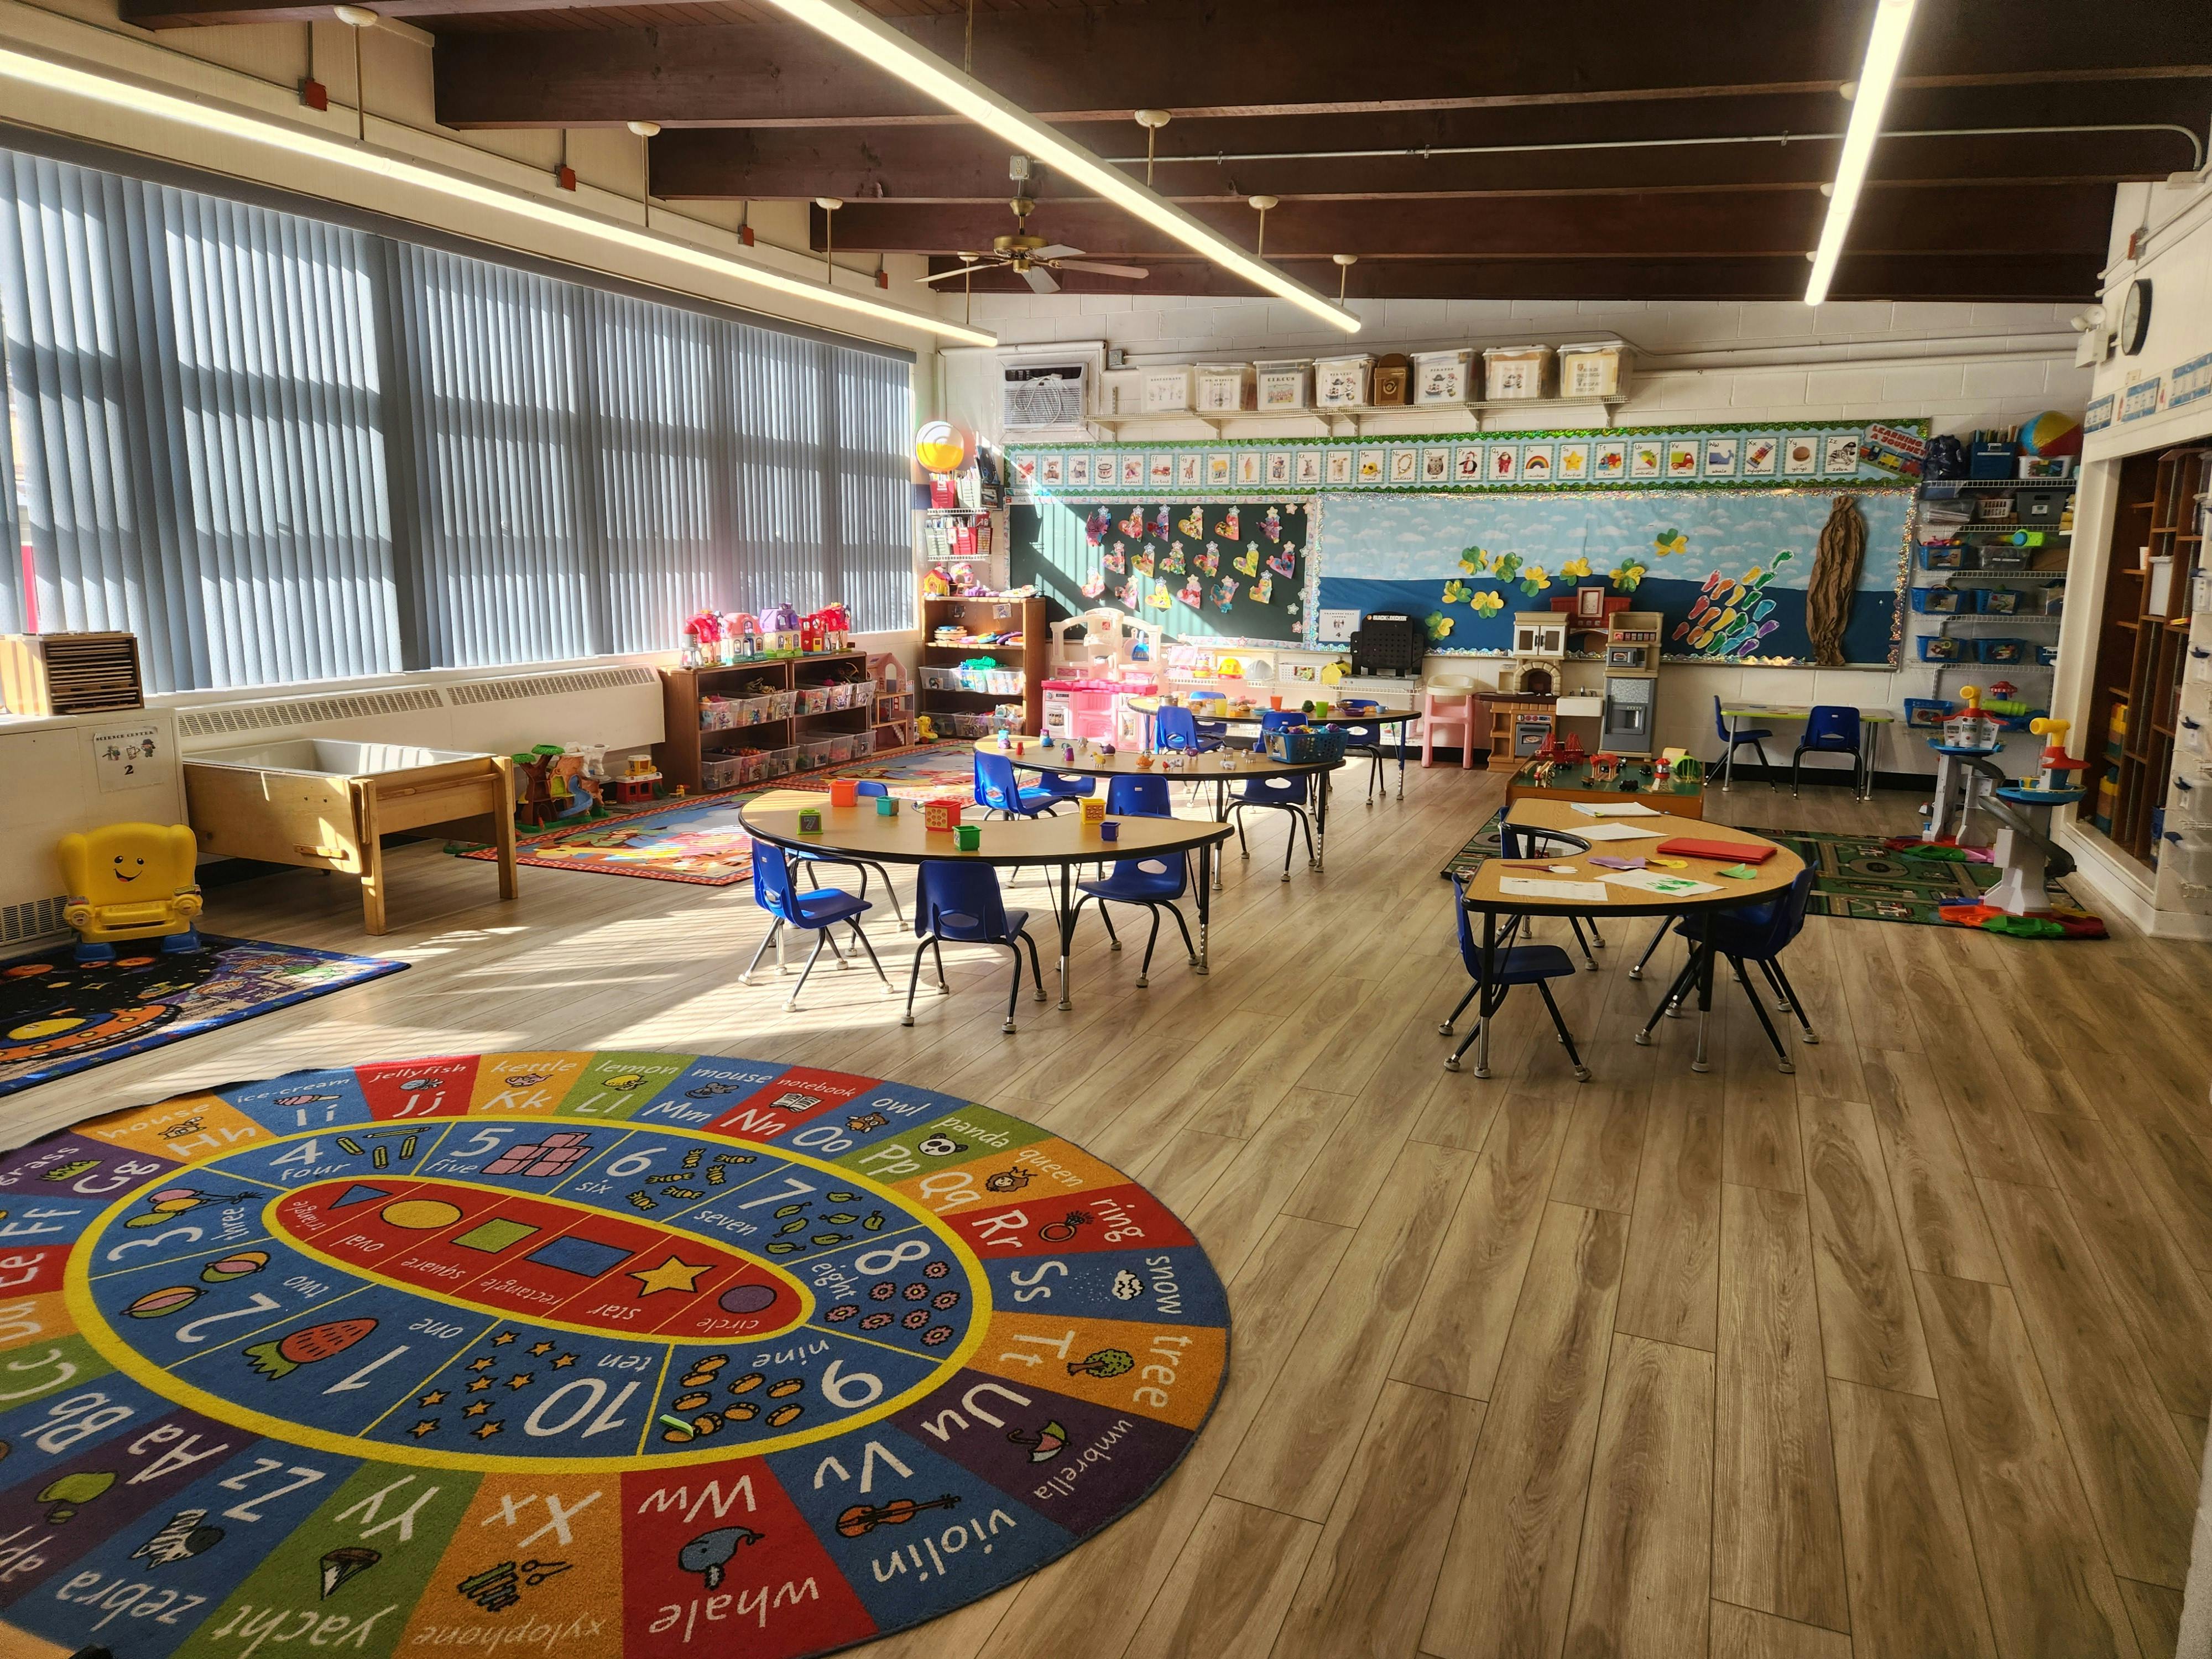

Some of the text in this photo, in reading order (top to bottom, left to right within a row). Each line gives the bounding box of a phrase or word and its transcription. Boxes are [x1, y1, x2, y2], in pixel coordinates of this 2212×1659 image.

[1788, 439, 1797, 448] Yy
[1872, 425, 1923, 447] LEARNING
[1881, 436, 1927, 456] JOURNEY
[1269, 454, 1275, 463] Jj
[124, 764, 134, 775] 2
[804, 816, 816, 830] 7
[372, 1062, 467, 1083] jellyfish
[492, 1058, 578, 1073] kettle
[594, 1060, 679, 1075] lemon
[691, 1065, 773, 1084] mouse
[236, 1076, 353, 1103] ice-cream
[479, 1092, 554, 1111] Kk
[777, 1076, 856, 1097] notebook
[295, 1103, 337, 1128] Ii
[393, 1092, 447, 1118] Jj
[576, 1094, 627, 1113] Ll
[643, 1100, 713, 1124] Mm
[870, 1094, 931, 1118] owl
[97, 1102, 210, 1140] house
[721, 1109, 779, 1137] Nn
[939, 1115, 1010, 1149] panda
[168, 1125, 257, 1157] Hh
[269, 1137, 324, 1167] 4
[450, 1126, 502, 1155] 5
[792, 1125, 853, 1155] Oo
[72, 1160, 160, 1193] Gg
[280, 1159, 352, 1181] four
[426, 1159, 478, 1177] five
[608, 1147, 666, 1177] 6
[858, 1143, 922, 1177] Pp
[1014, 1146, 1084, 1188] queen
[575, 1178, 613, 1196] six
[738, 1177, 817, 1211] 7
[919, 1171, 983, 1213] Qq
[210, 1206, 245, 1241] three
[291, 1199, 326, 1238] triangle
[693, 1207, 759, 1238] seven
[971, 1209, 1029, 1250] Rr
[1089, 1195, 1145, 1243] ring
[106, 1226, 204, 1261] 3
[329, 1233, 387, 1254] oval
[854, 1239, 932, 1276] 8
[400, 1256, 468, 1284] square
[810, 1261, 856, 1301] eight
[1011, 1261, 1068, 1302] Ss
[1144, 1255, 1182, 1315] snow
[283, 1274, 331, 1300] two
[478, 1277, 565, 1319] rectangle
[175, 1291, 281, 1343] 2
[587, 1301, 643, 1321] star
[695, 1317, 760, 1333] circle
[408, 1317, 463, 1340] one
[597, 1353, 651, 1373] ten
[753, 1338, 829, 1368] nine
[1000, 1329, 1076, 1369] Tt
[322, 1345, 410, 1395] 1
[819, 1359, 883, 1410] 9
[1134, 1335, 1193, 1410] tree
[21, 1392, 135, 1454] Bb
[523, 1377, 640, 1439] 10
[920, 1384, 1032, 1442] Uu
[126, 1423, 228, 1484] Aa
[812, 1441, 914, 1494] Vv
[1032, 1419, 1133, 1502] umbrella
[218, 1457, 327, 1522] Zz
[639, 1474, 755, 1522] Ww
[333, 1474, 441, 1542] Yy
[481, 1490, 602, 1548] Xx
[872, 1510, 1017, 1586] violin
[56, 1571, 206, 1632] zebra
[649, 1576, 820, 1643] whale
[210, 1600, 398, 1659] yacht
[415, 1617, 607, 1653] xylophone
